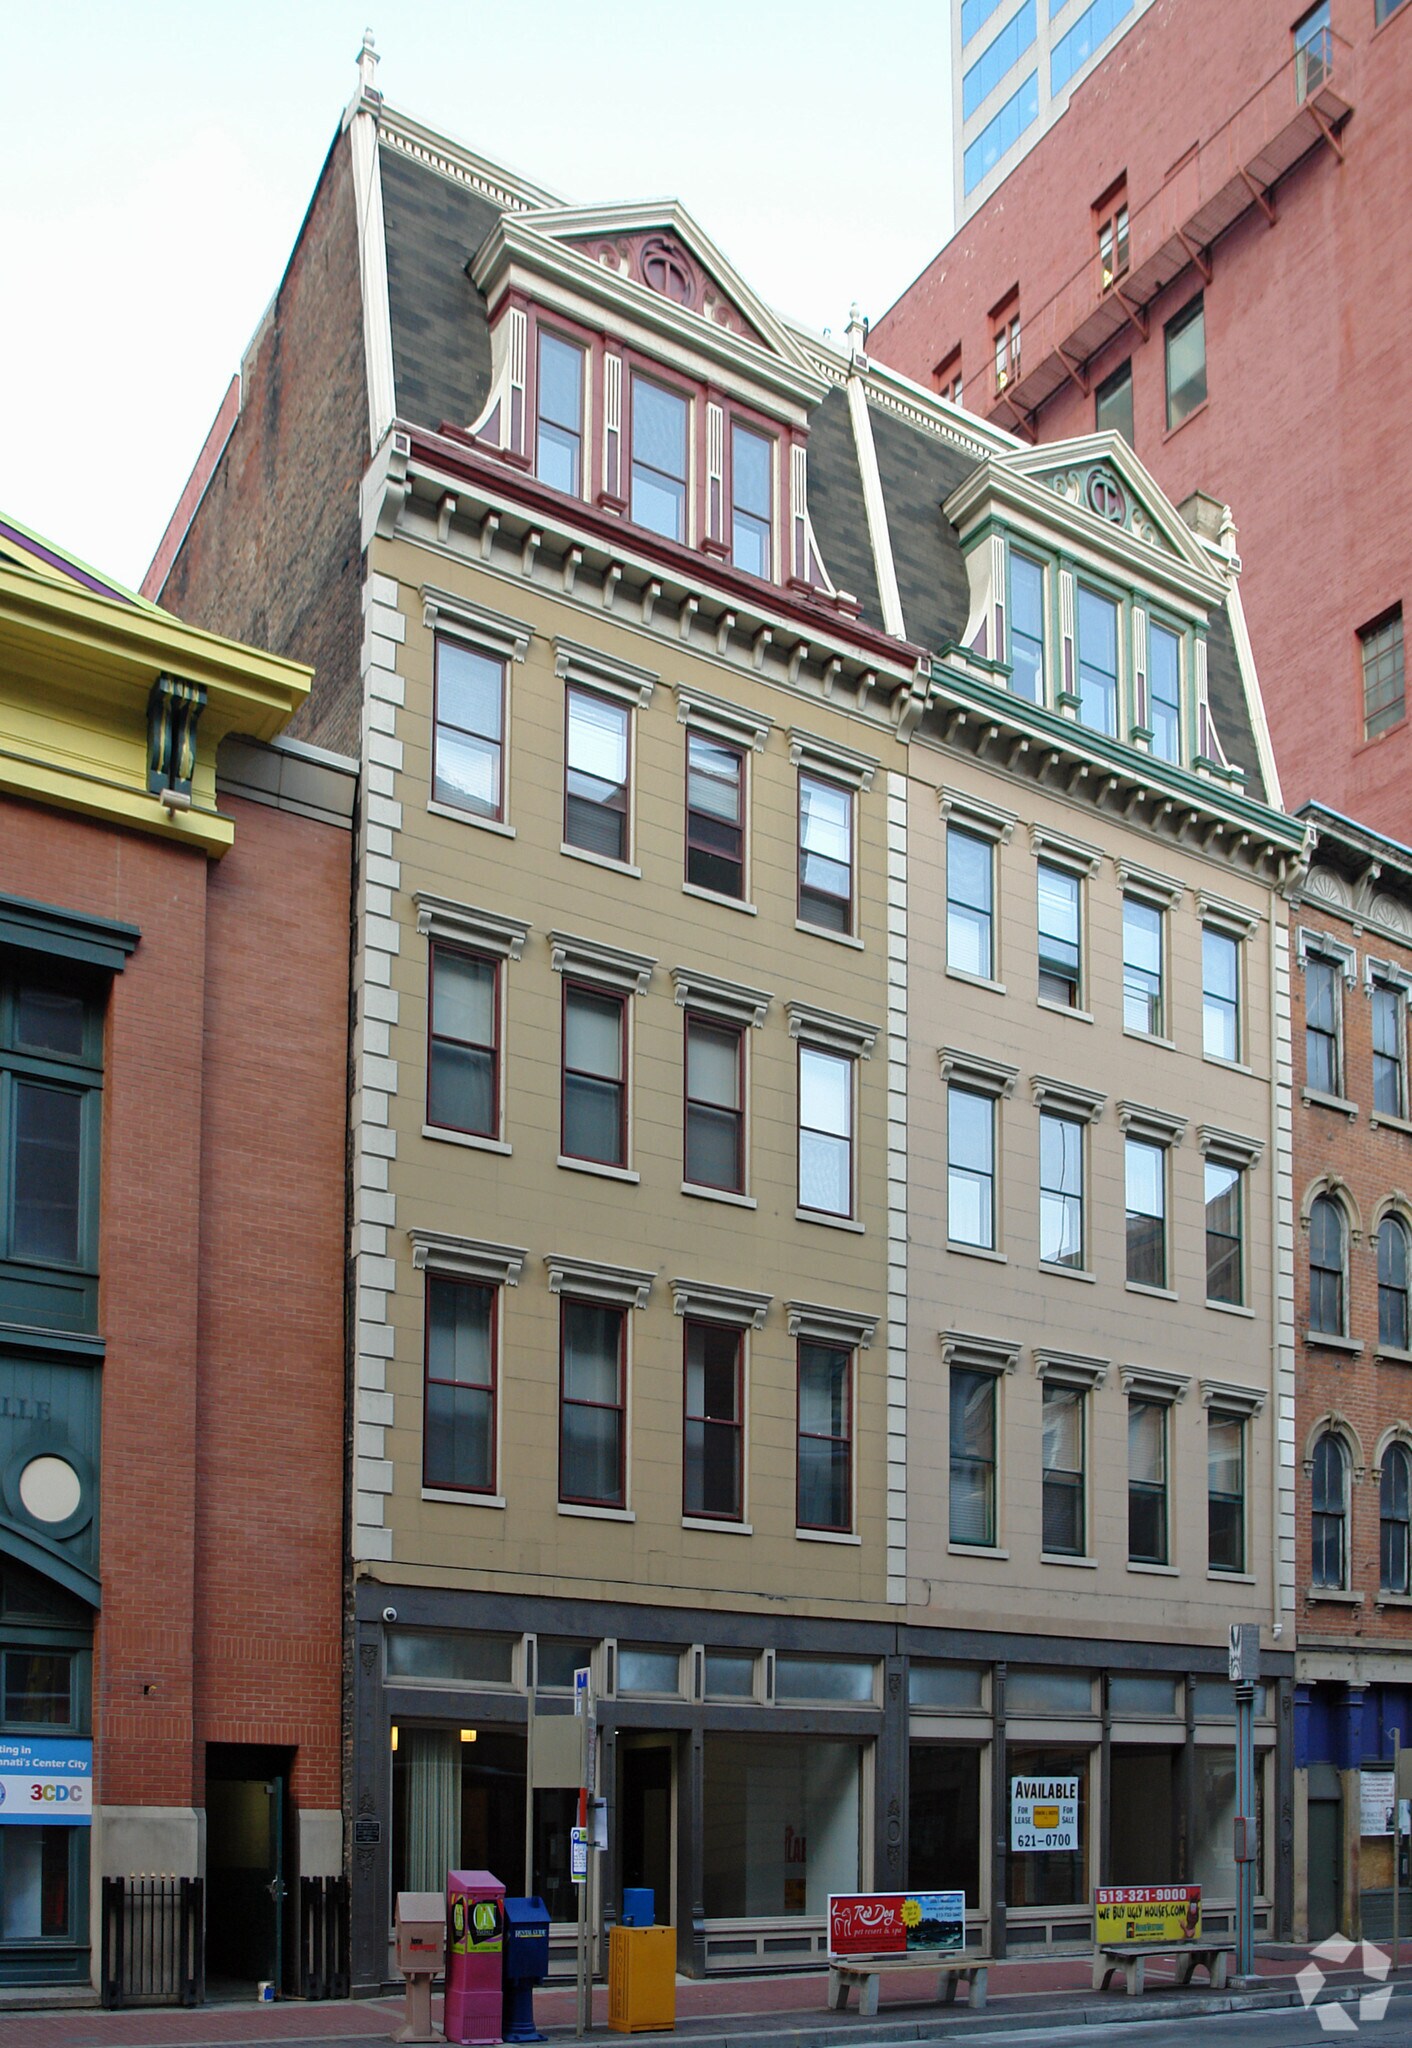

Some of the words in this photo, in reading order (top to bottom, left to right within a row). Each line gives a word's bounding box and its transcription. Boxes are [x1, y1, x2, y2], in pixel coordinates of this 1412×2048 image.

[21, 1745, 31, 1754] in
[32, 1759, 66, 1768] Center
[68, 1760, 88, 1770] City
[30, 1784, 83, 1802] 3CDC
[1015, 1781, 1076, 1799] AVAILABLE
[1018, 1805, 1028, 1814] FOR
[1063, 1805, 1073, 1814] FOR
[1014, 1816, 1031, 1824] LEASE
[1062, 1816, 1074, 1824] SALE
[1018, 1833, 1071, 1847] 621-0700
[1099, 1888, 1187, 1903] 513-321-9000
[854, 1905, 873, 1922] Red
[874, 1904, 896, 1926] Dog
[1098, 1907, 1110, 1920] WE
[1113, 1905, 1125, 1920] BUY
[1127, 1905, 1142, 1919] UGLY
[1144, 1904, 1186, 1918] HOUSES.COM
